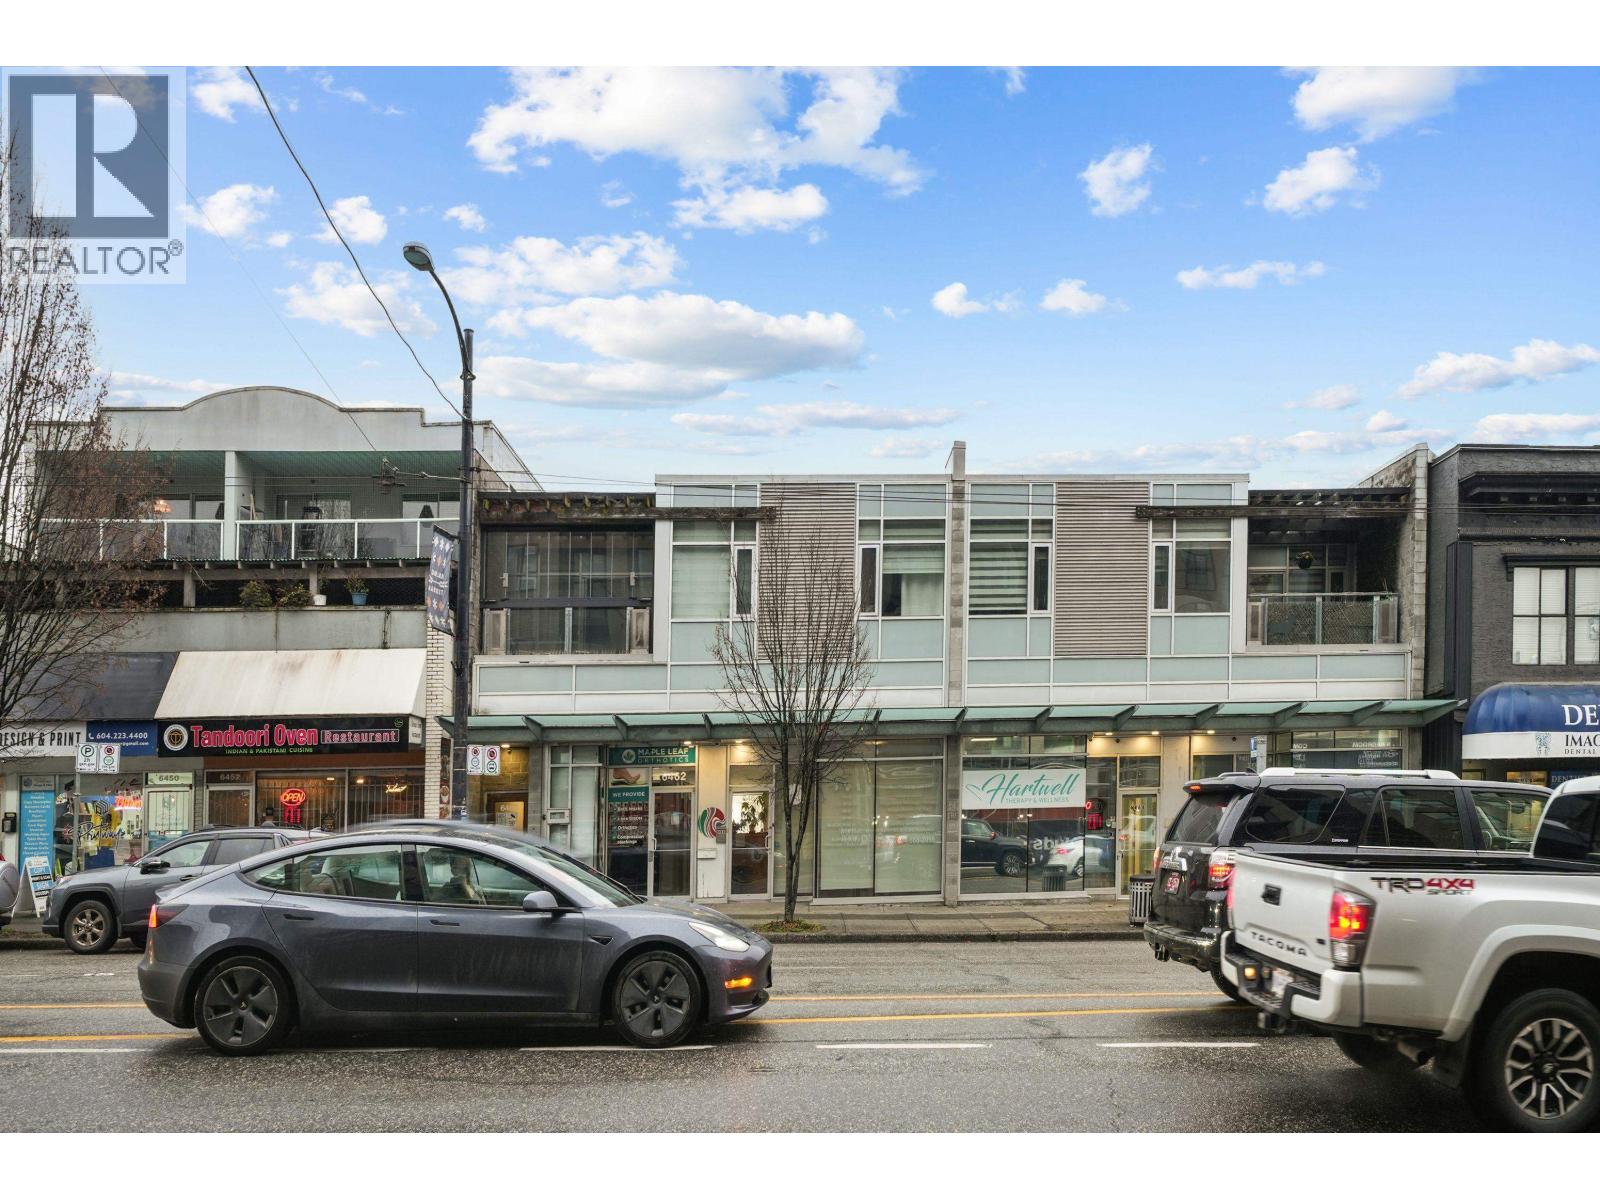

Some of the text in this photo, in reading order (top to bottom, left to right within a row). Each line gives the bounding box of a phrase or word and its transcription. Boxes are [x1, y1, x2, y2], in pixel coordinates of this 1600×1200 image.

[1561, 704, 1600, 726] DE
[38, 732, 45, 746] &
[50, 732, 81, 746] PRINT
[190, 724, 270, 748] Tandoori
[274, 724, 319, 746] Oven
[324, 730, 396, 743] Restaurant
[667, 747, 689, 755] LEAF
[661, 772, 687, 781] 6462
[282, 793, 304, 802] OPEN
[981, 773, 1080, 806] Hartwell
[1369, 877, 1425, 894] TRD
[1251, 931, 1308, 956] TACOMA
